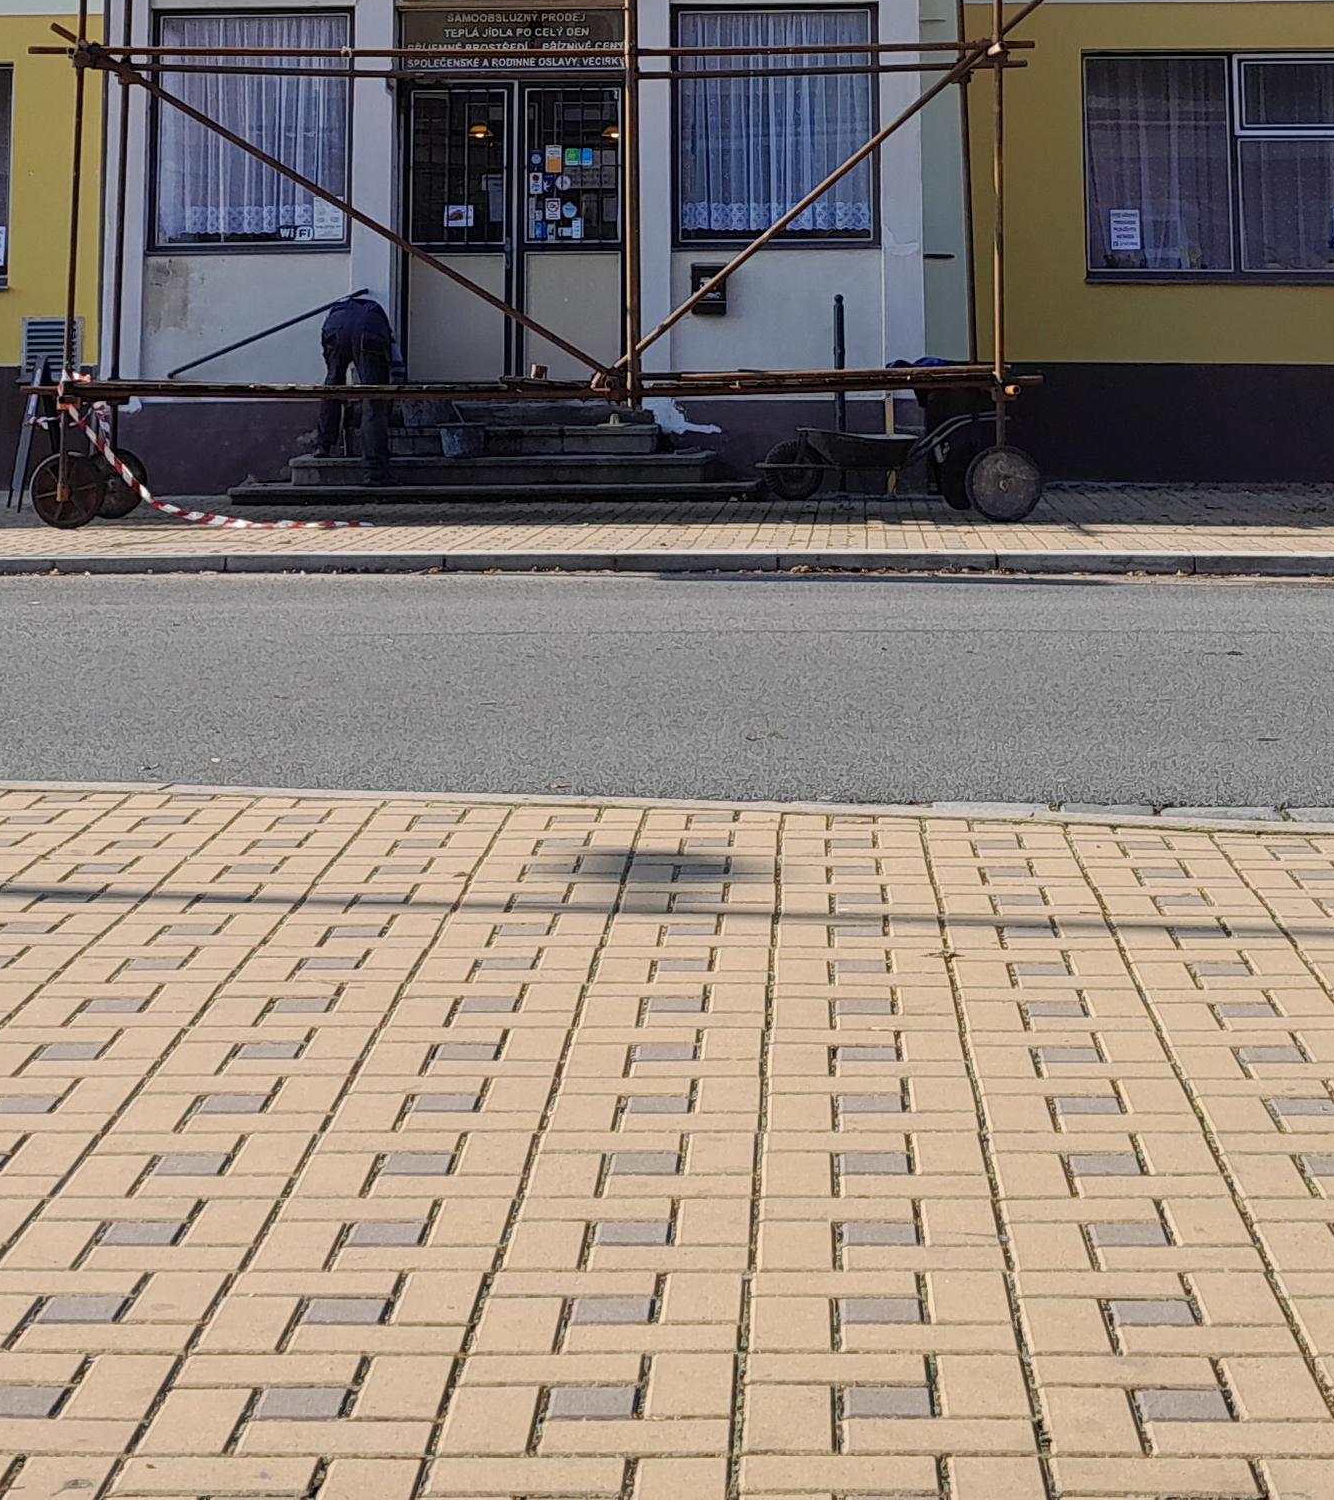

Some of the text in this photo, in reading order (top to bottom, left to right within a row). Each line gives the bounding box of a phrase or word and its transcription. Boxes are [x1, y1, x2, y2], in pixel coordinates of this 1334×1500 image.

[541, 12, 586, 22] PRODEJ
[444, 26, 590, 38] TEPLÁ JÍDLA PO CELÝ DEN
[482, 58, 490, 67] A
